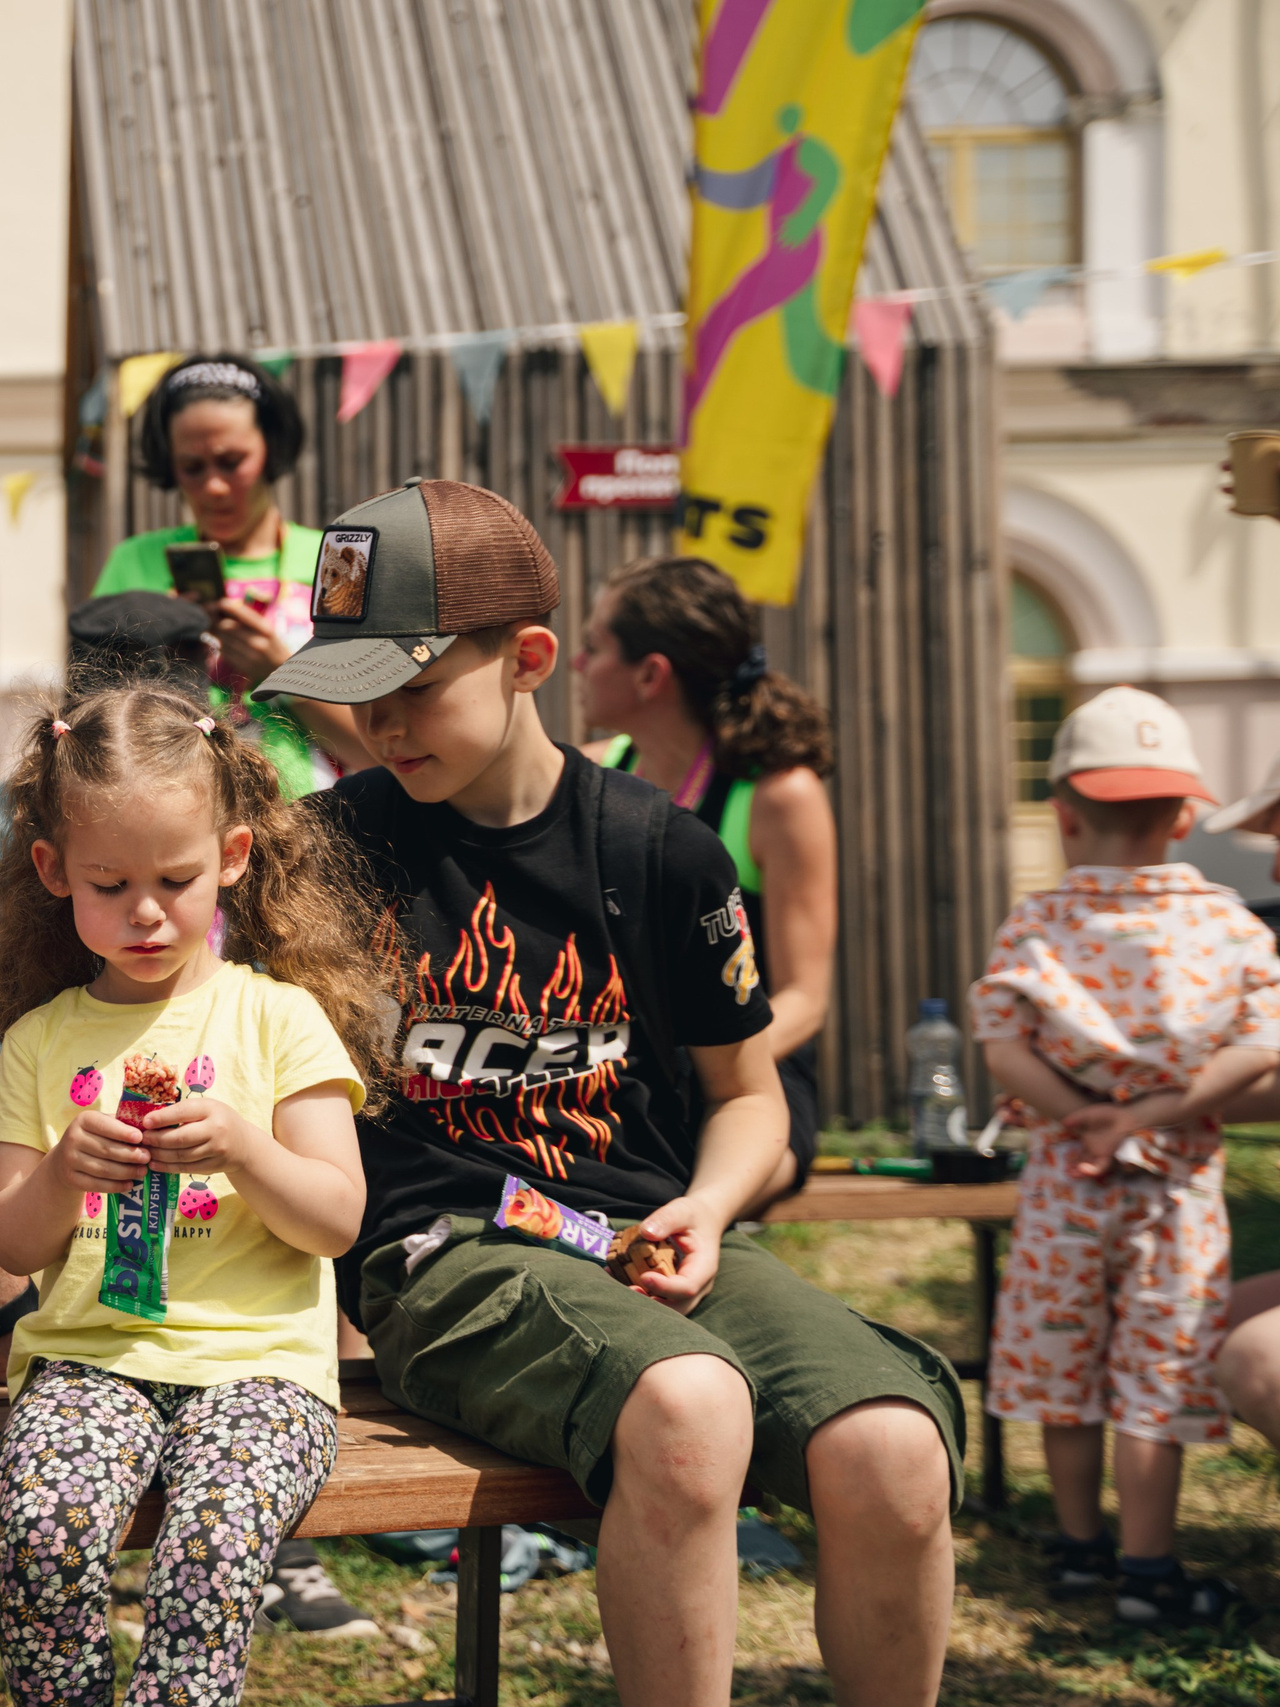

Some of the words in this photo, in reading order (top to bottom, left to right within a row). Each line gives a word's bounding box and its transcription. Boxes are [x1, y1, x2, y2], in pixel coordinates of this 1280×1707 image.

[335, 533, 371, 543] GRIZZLY
[684, 498, 771, 549] TS
[1135, 720, 1162, 751] C
[148, 1173, 161, 1229] КЛУБНИ
[107, 1183, 149, 1298] bigSTA
[174, 1226, 212, 1238] HAPPY
